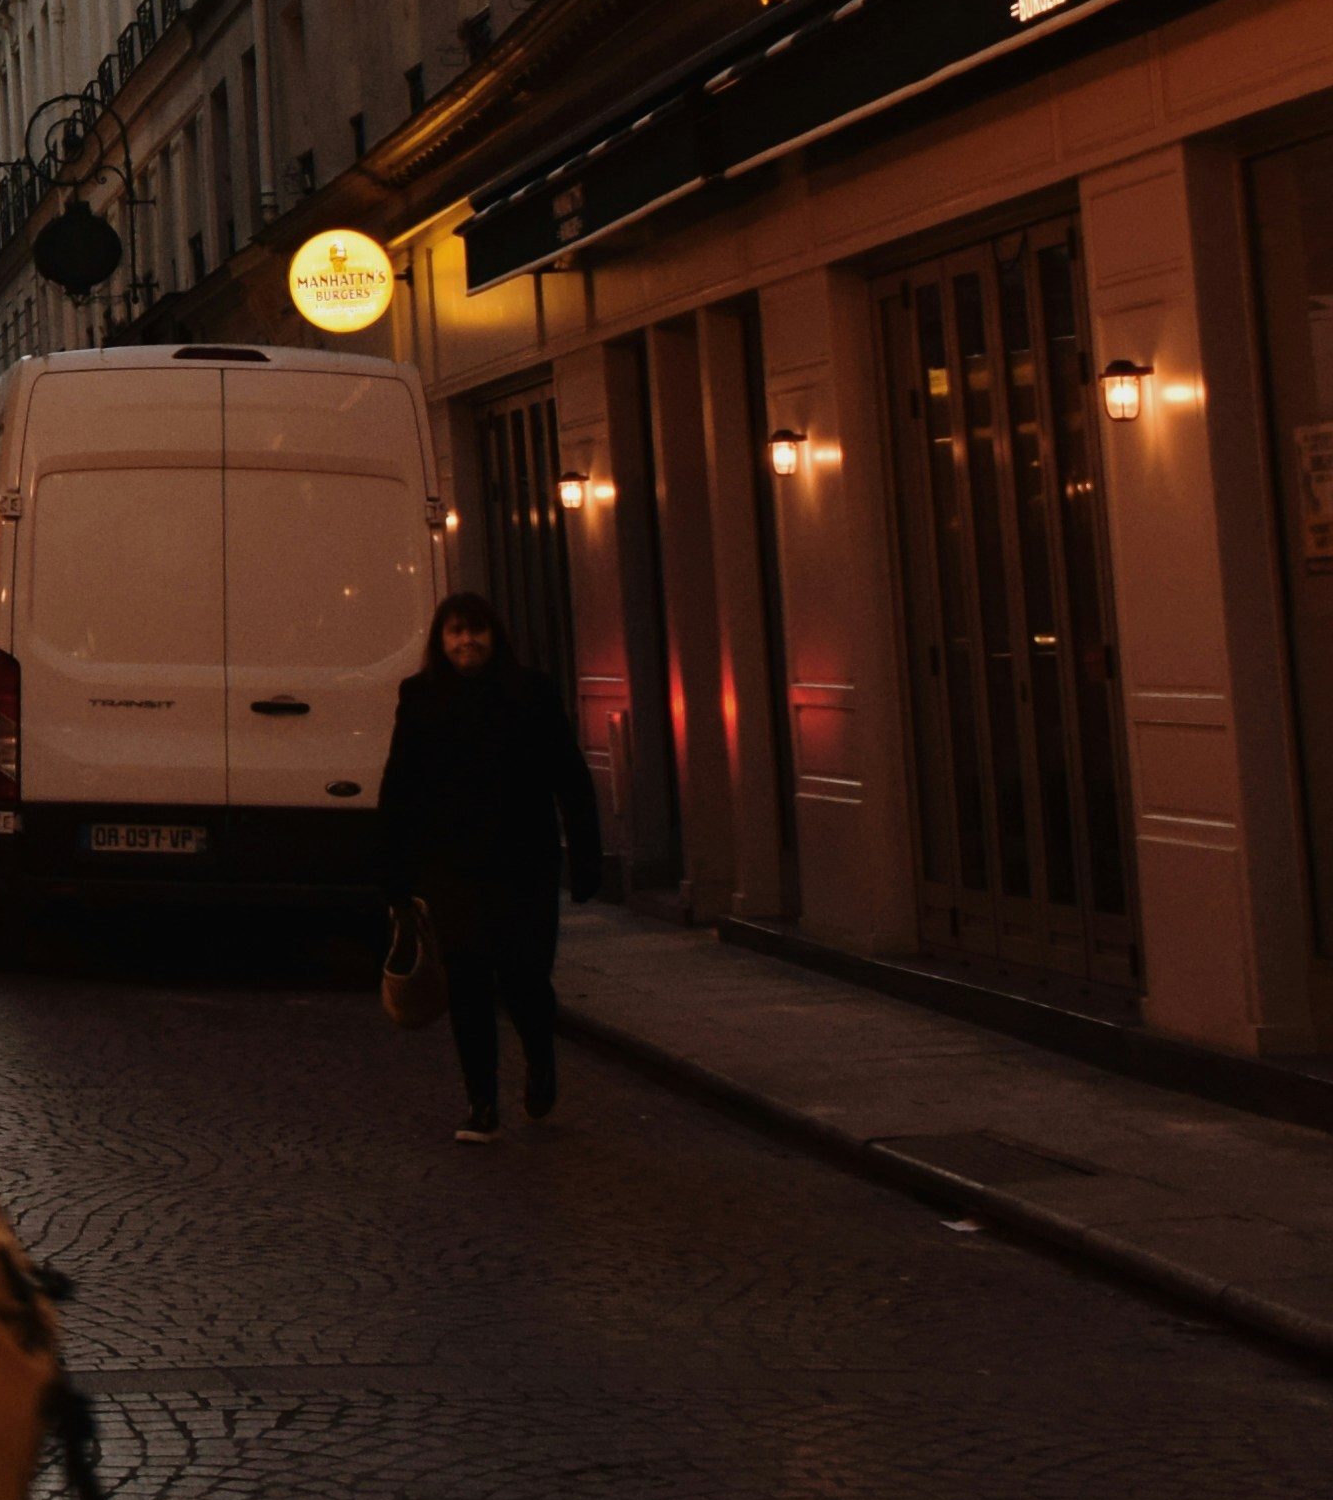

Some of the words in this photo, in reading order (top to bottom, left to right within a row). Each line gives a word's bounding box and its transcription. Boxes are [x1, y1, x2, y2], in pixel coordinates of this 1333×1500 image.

[296, 269, 387, 288] MANHATTN'S
[315, 289, 371, 302] BURGERS
[88, 699, 175, 709] TRANSIT
